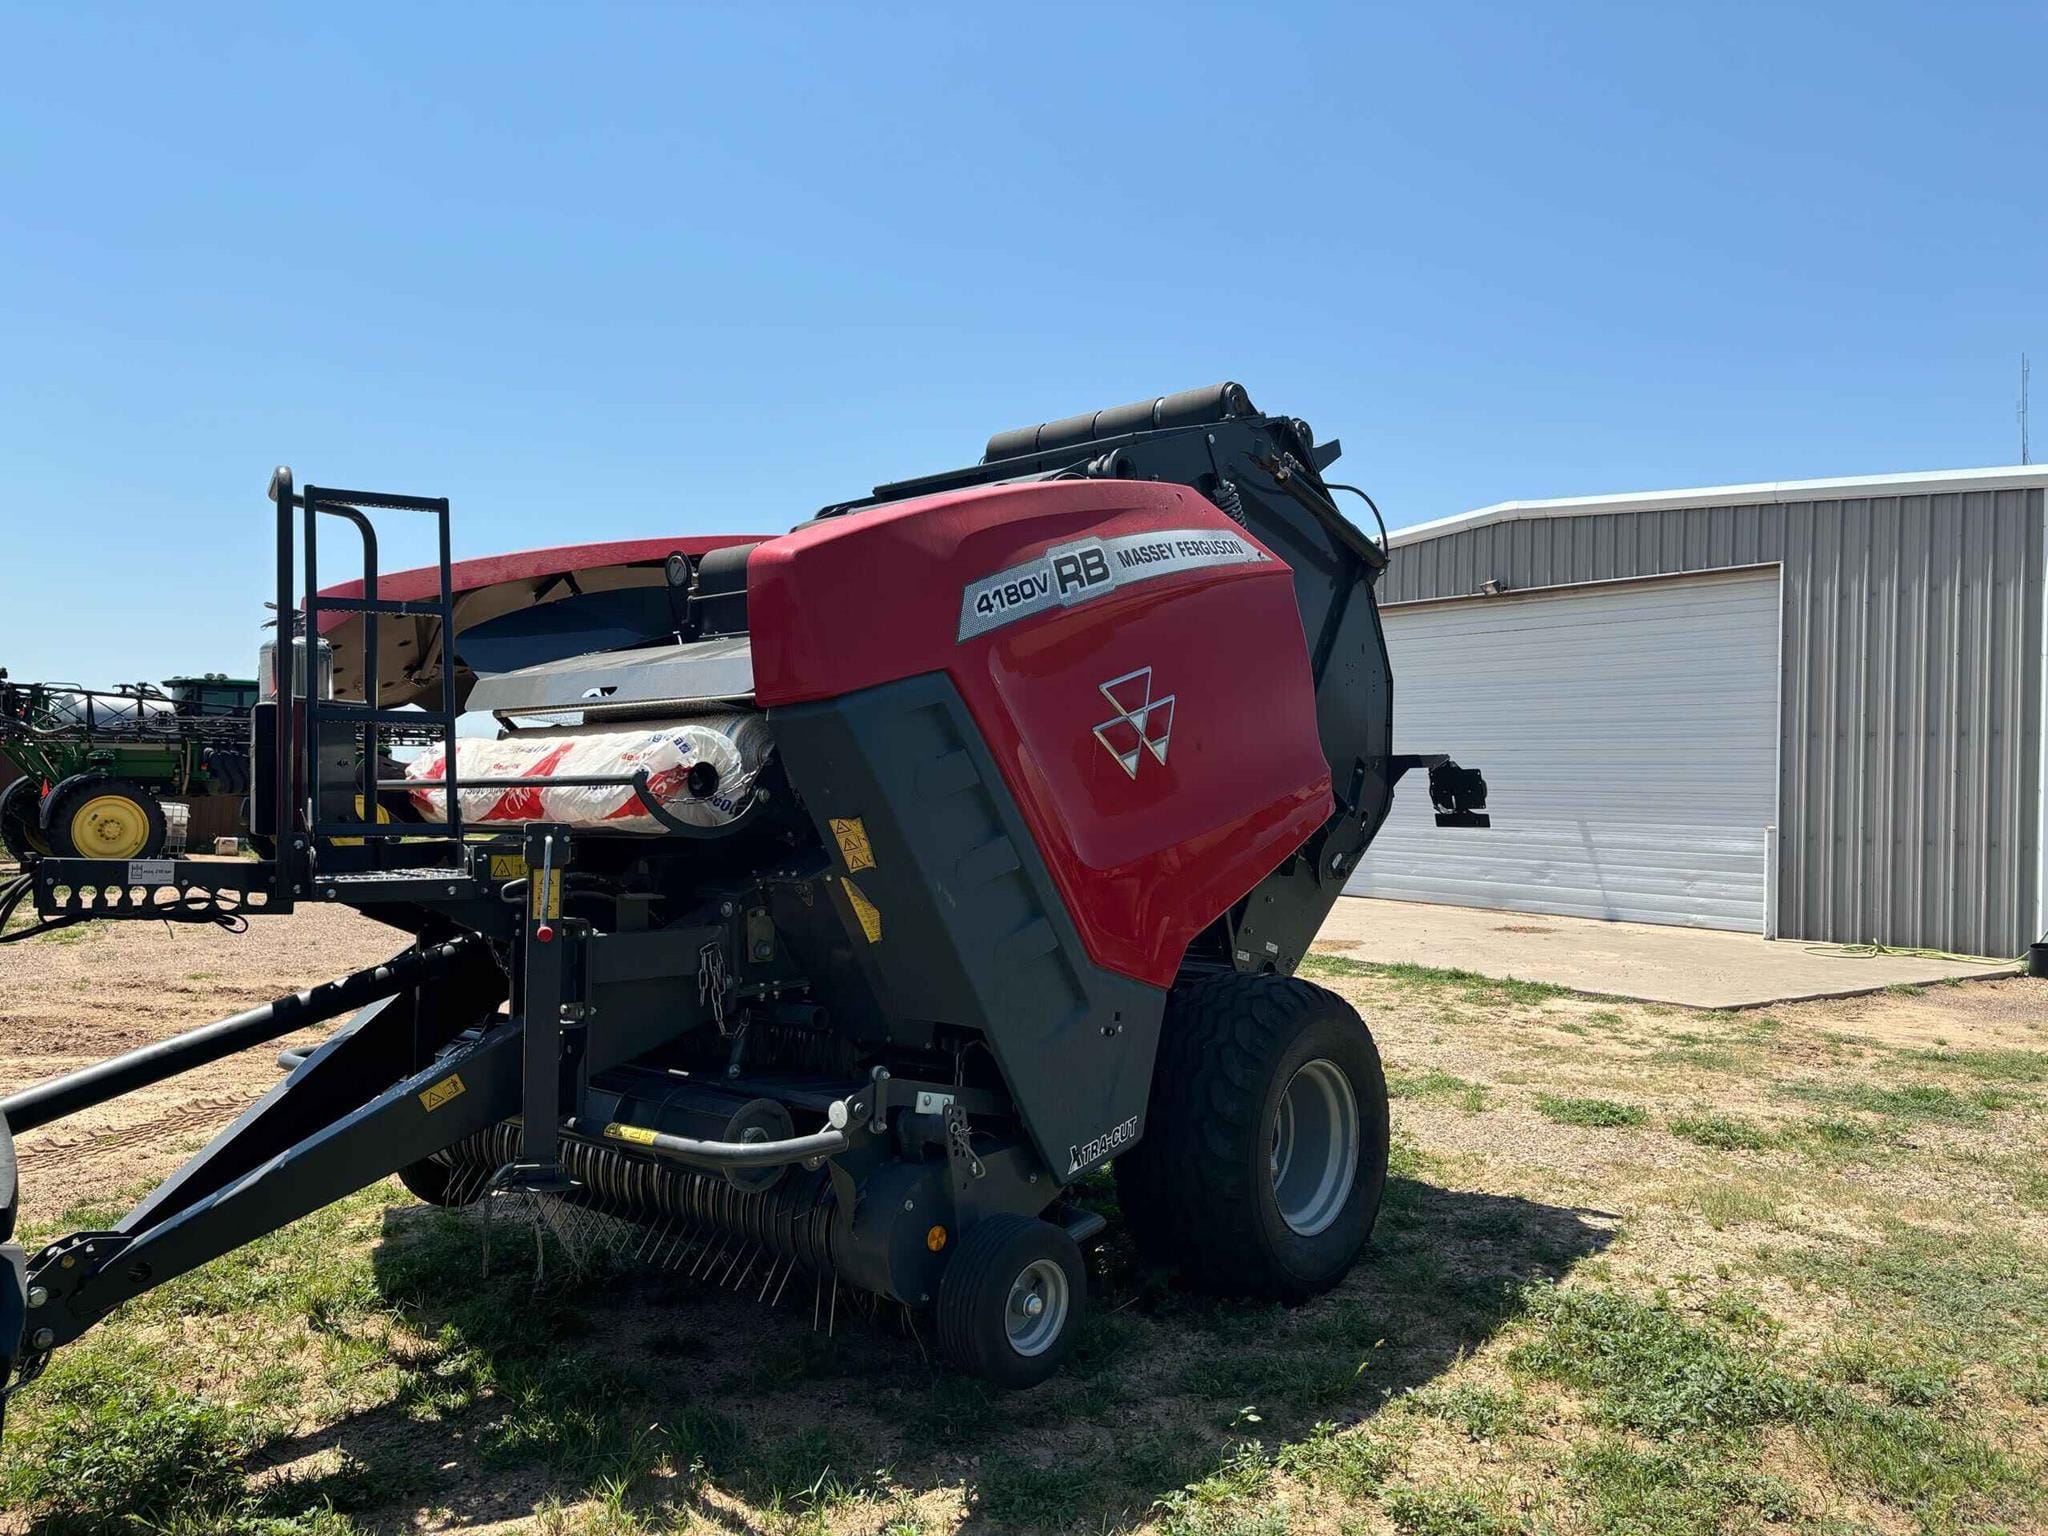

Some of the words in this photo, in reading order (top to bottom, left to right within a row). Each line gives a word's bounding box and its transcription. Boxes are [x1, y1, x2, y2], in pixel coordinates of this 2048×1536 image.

[976, 572, 1047, 613] 4180V
[1053, 548, 1110, 594] RB
[1116, 542, 1175, 568] MASSEY
[1176, 540, 1243, 558] FERGUSON
